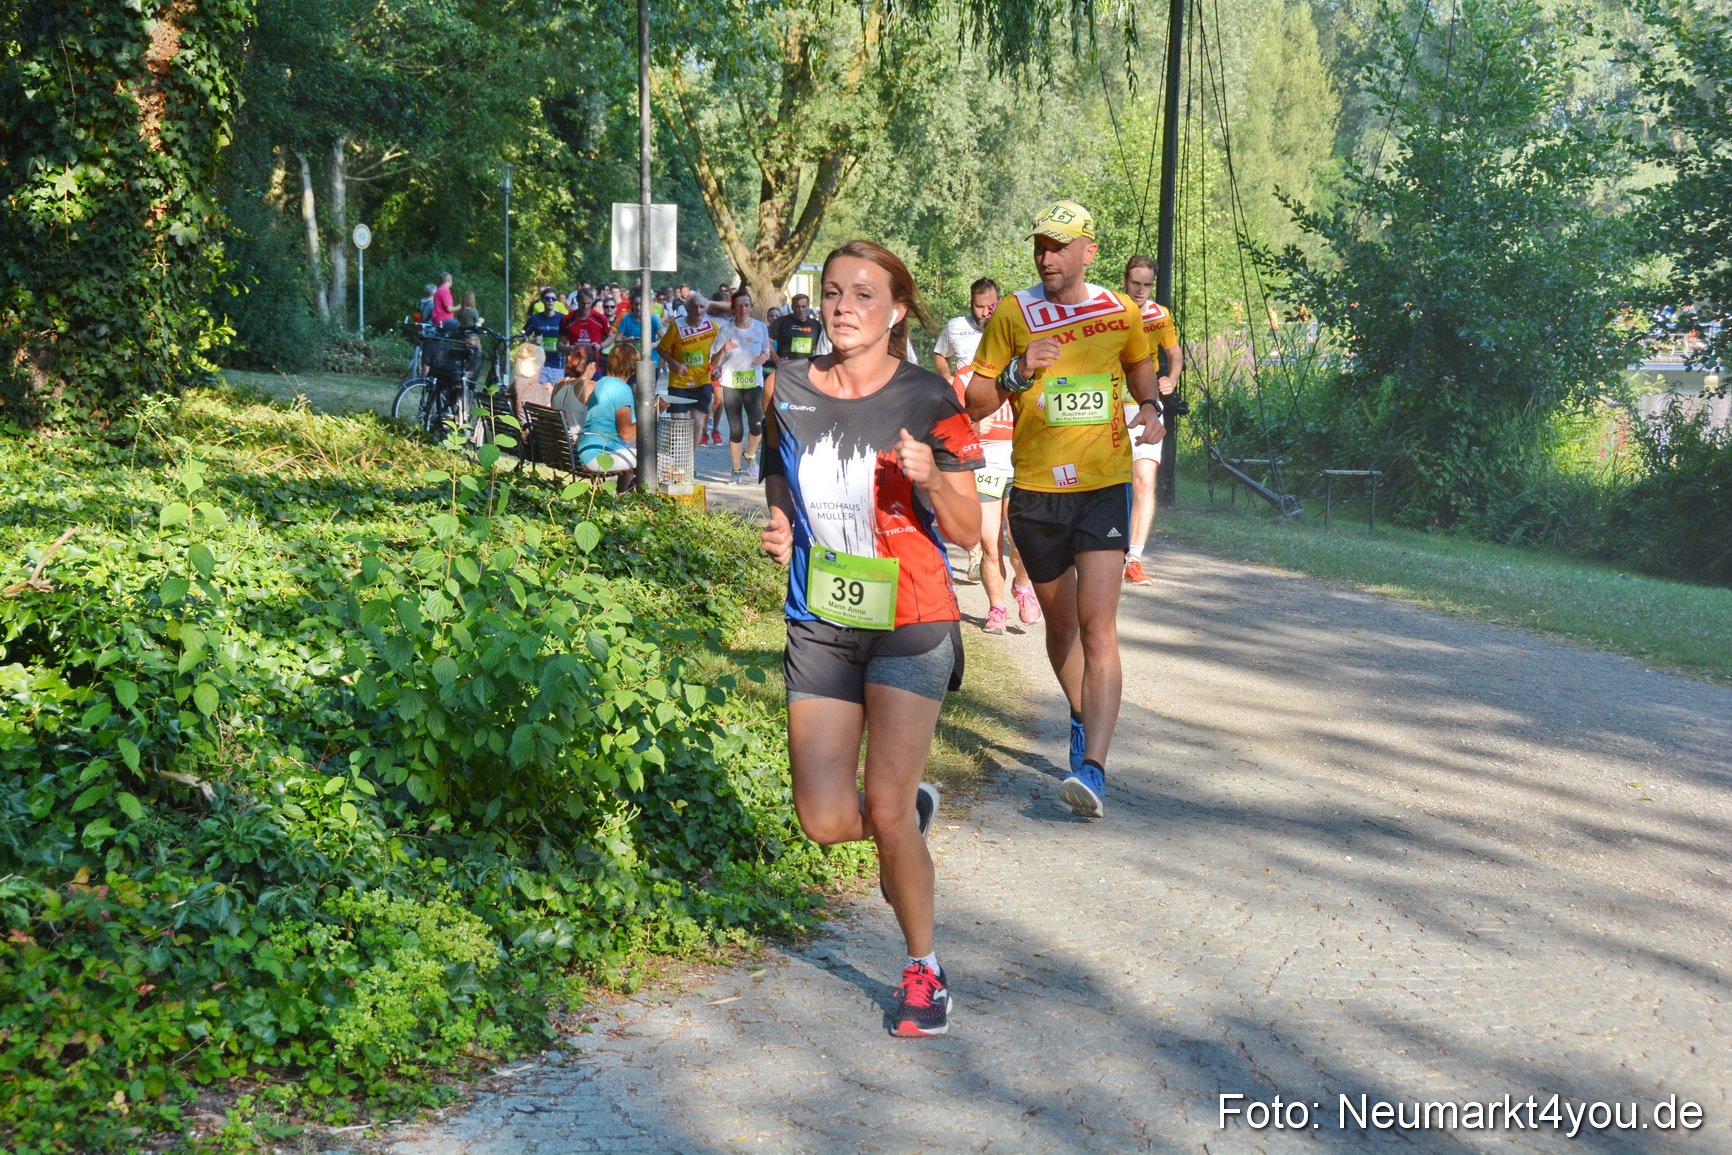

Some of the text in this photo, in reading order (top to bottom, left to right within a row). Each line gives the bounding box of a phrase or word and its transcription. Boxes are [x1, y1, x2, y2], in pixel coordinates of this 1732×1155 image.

[1040, 204, 1076, 224] 46
[1051, 319, 1131, 345] AX BÖGL
[1143, 321, 1167, 334] BÖGL
[681, 332, 715, 346] MAX BÖGL
[685, 355, 702, 364] 1289
[735, 376, 754, 384] 1006
[1053, 391, 1104, 411] 1329
[809, 502, 861, 512] AUTOHAUS
[817, 511, 855, 521] MÜLLER
[831, 576, 865, 606] 39
[827, 600, 867, 616] Mann Anne
